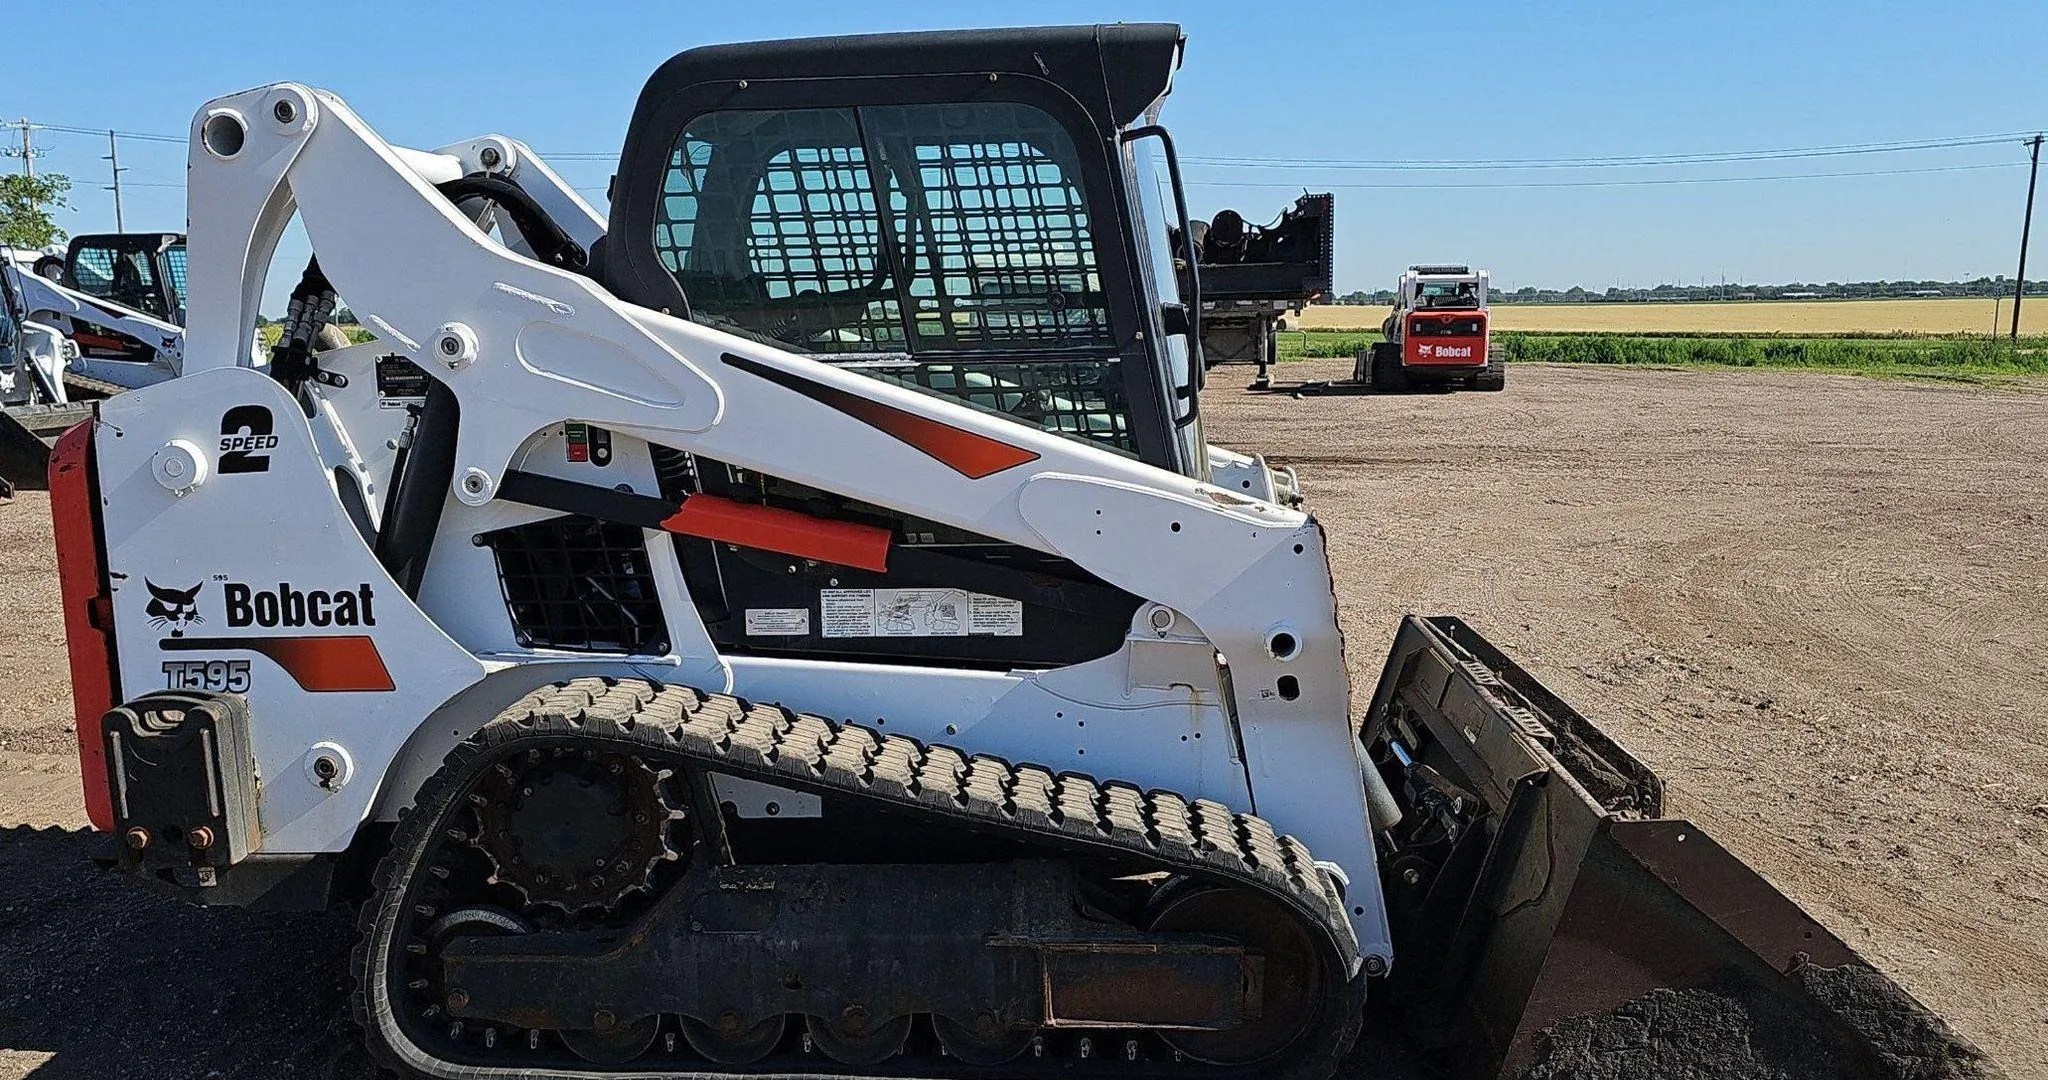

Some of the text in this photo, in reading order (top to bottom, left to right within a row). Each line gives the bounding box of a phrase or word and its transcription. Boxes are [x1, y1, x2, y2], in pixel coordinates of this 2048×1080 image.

[1435, 345, 1471, 357] Bobcat
[218, 405, 273, 474] 2
[219, 436, 279, 451] SPEED
[224, 582, 376, 628] Bobcat
[161, 659, 251, 693] T595
